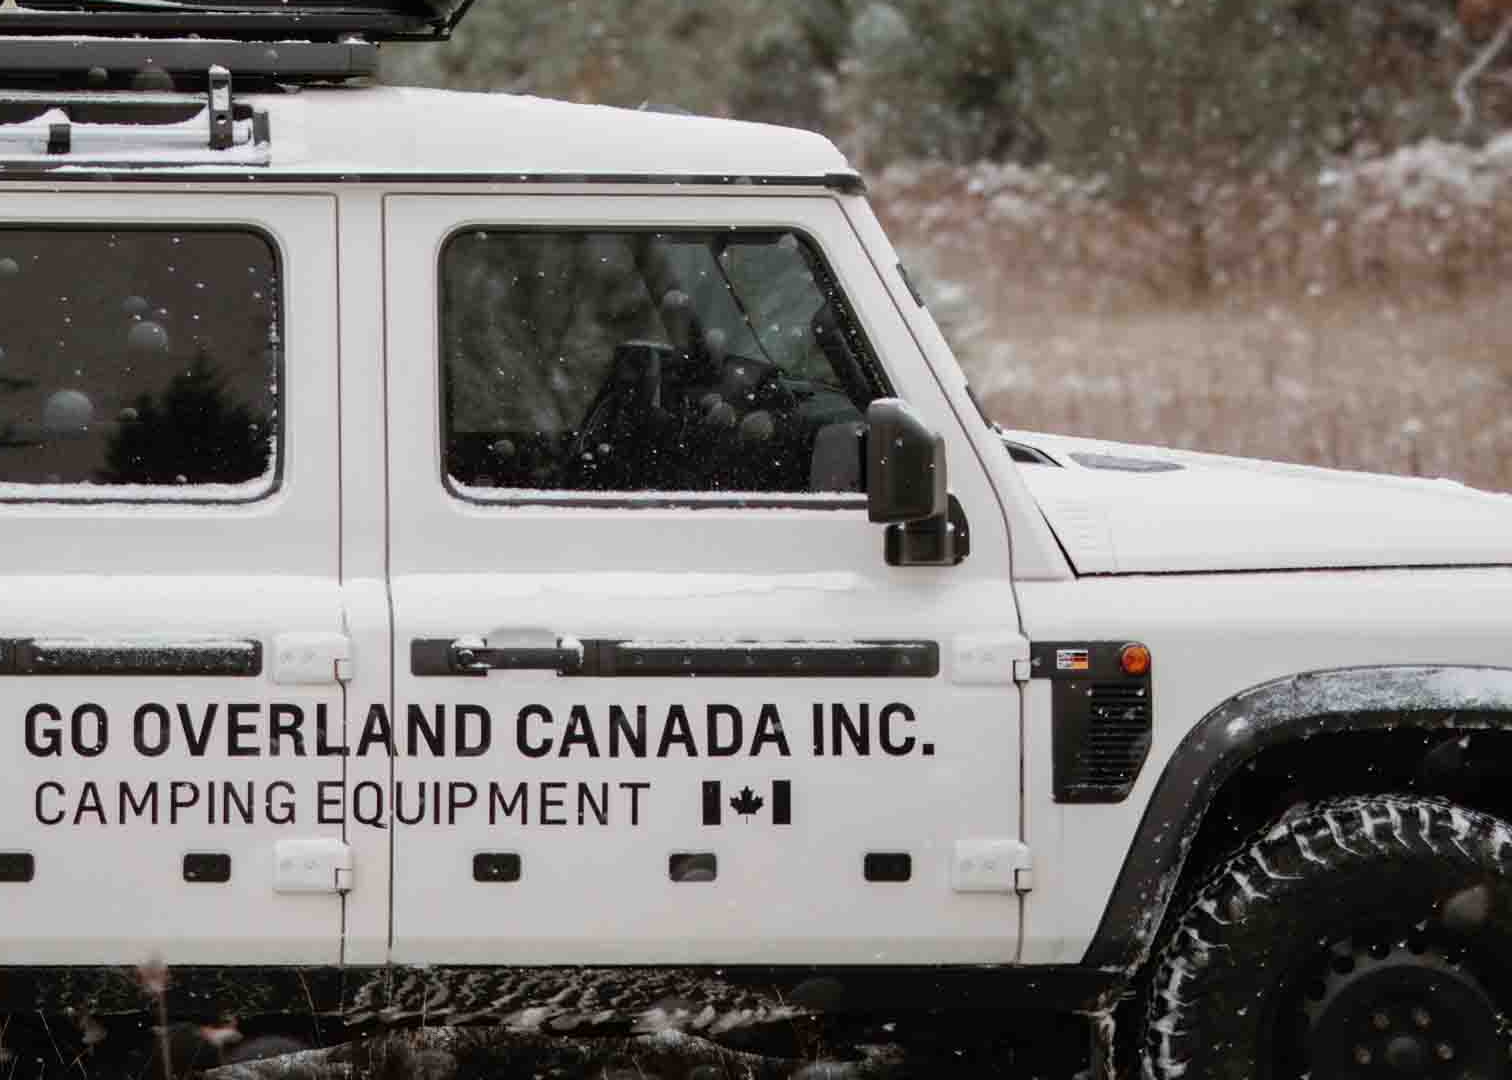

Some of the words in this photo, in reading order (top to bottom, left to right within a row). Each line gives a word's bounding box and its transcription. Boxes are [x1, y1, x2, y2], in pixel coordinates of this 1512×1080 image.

[24, 702, 109, 758] GO
[133, 702, 492, 758] OVERLAND
[516, 702, 792, 759] CANADA
[812, 702, 935, 758] INC.
[35, 780, 296, 826] CAMPING
[315, 780, 651, 829] EQUIPMENT
